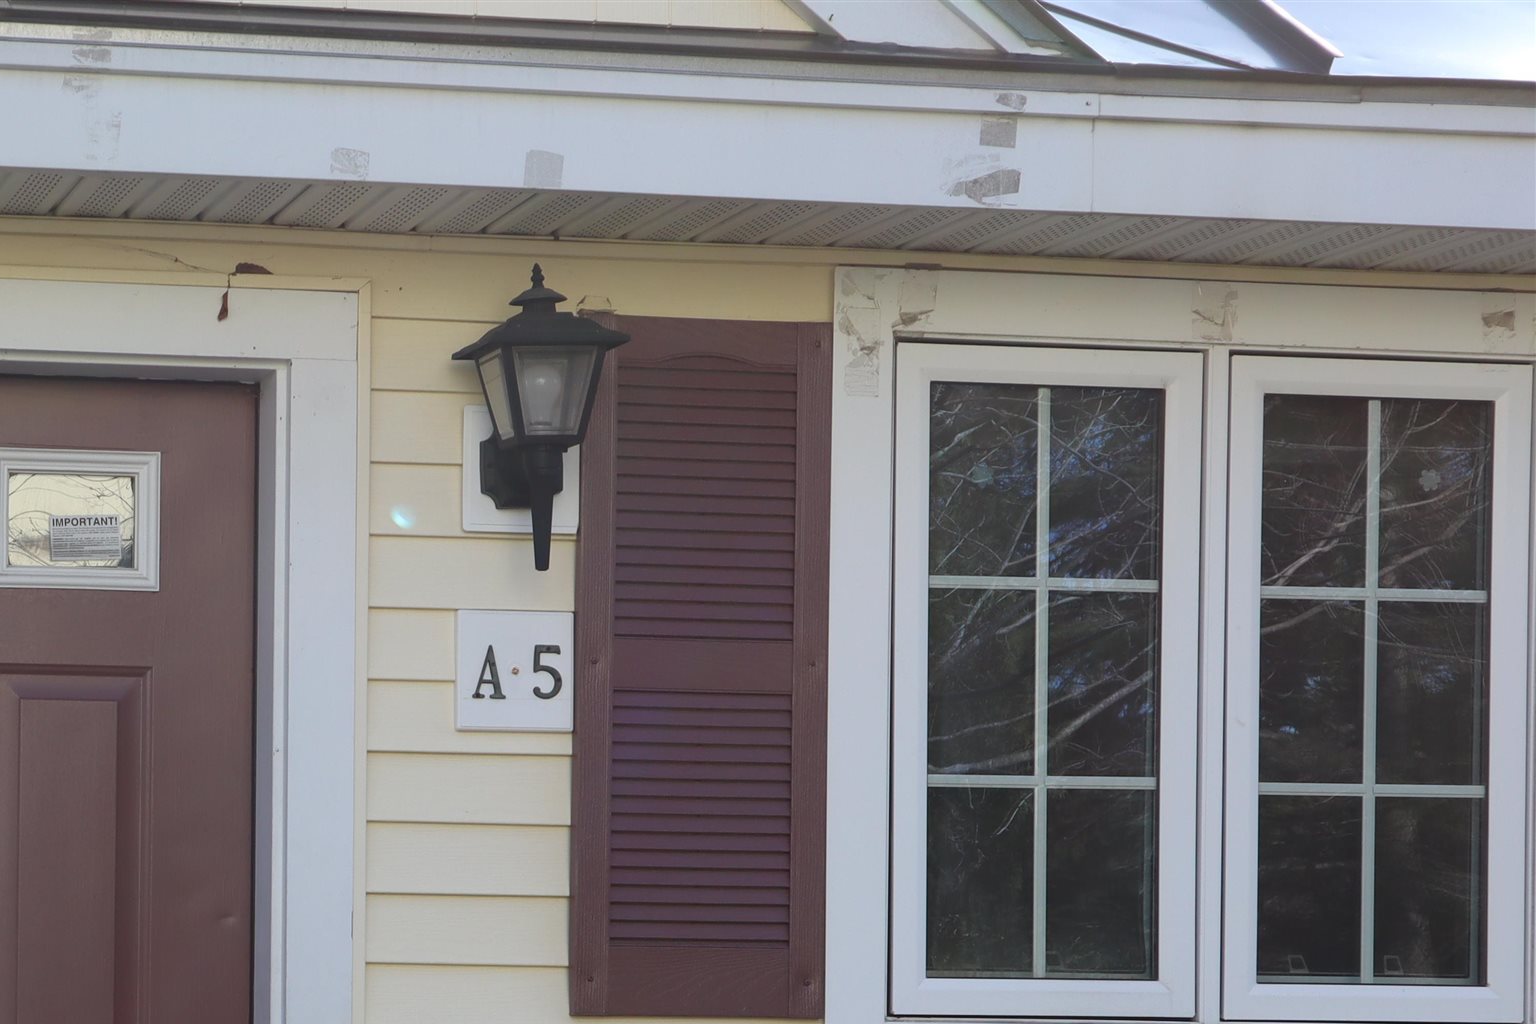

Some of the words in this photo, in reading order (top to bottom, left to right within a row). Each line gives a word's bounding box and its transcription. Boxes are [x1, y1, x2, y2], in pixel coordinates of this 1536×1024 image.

[52, 516, 118, 527] IMPORTANT!
[472, 644, 506, 699] A
[532, 644, 562, 699] 5
